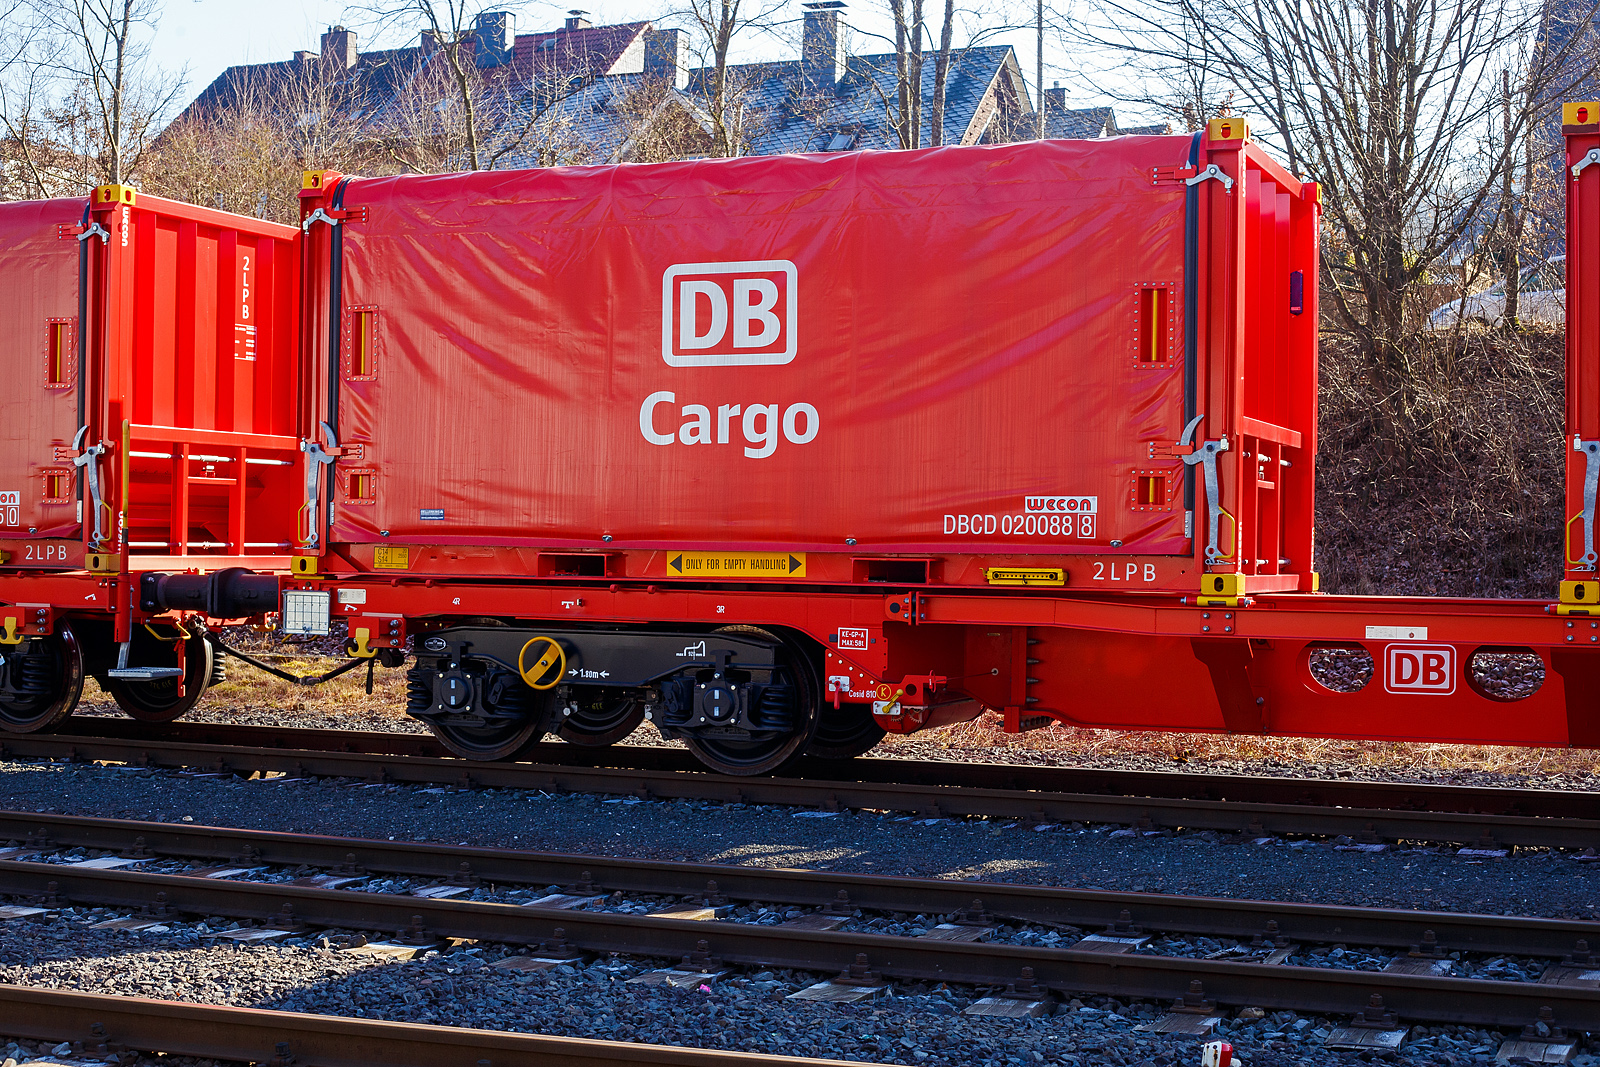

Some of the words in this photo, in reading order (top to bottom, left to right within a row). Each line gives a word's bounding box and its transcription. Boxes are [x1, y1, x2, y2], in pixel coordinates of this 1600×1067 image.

[121, 206, 129, 247] wecon
[679, 278, 781, 350] DB
[639, 391, 820, 459] Cargo
[0, 493, 16, 503] on
[1026, 498, 1092, 511] wecon
[943, 514, 997, 535] DBCD
[1001, 515, 1073, 536] 020088
[1080, 515, 1092, 536] 8
[25, 544, 67, 560] 2LPB
[685, 558, 703, 570] ONLY
[706, 558, 720, 570] FOR
[724, 558, 747, 570] EMPTY
[750, 559, 786, 570] HANDLING
[1092, 562, 1156, 582] 2LPB
[716, 605, 725, 614] 3R
[1394, 652, 1447, 686] DB
[848, 689, 865, 698] Cosid
[865, 690, 877, 699] 810
